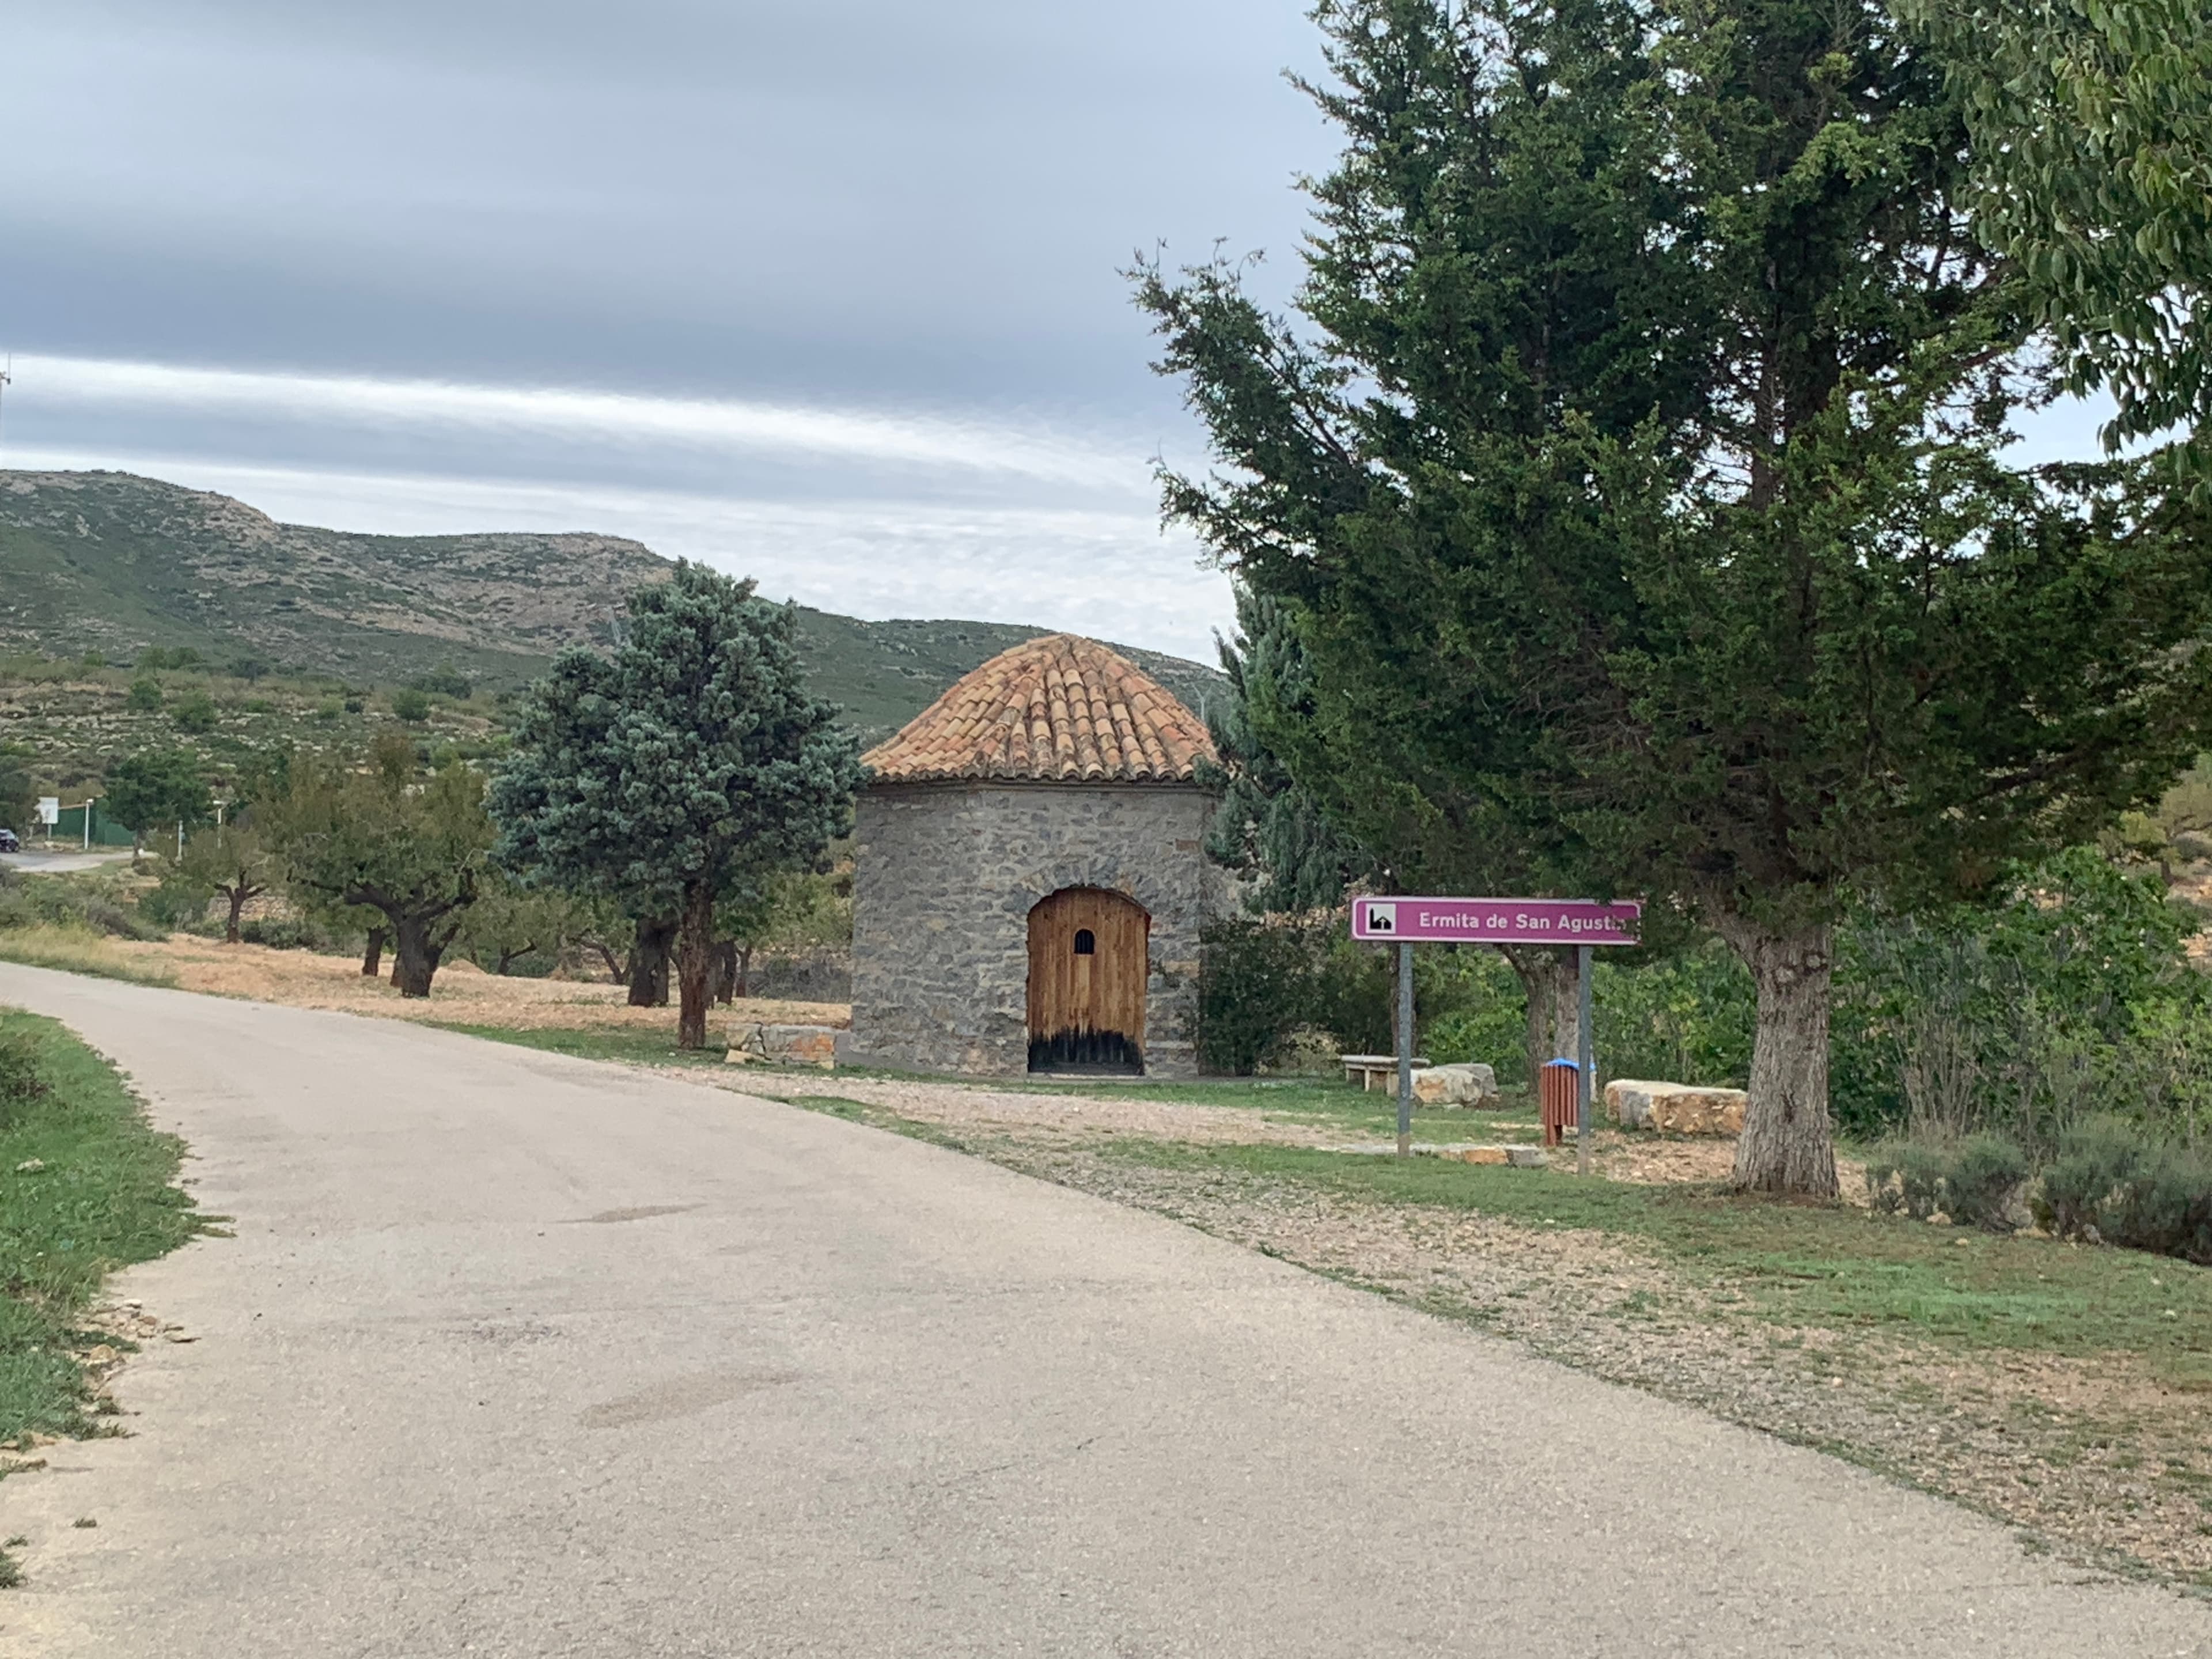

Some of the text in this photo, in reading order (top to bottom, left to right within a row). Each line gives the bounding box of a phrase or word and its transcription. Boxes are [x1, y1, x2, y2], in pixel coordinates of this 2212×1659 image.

[1419, 912, 1479, 929] Ermita
[1486, 913, 1508, 929] de
[1516, 914, 1550, 929] San
